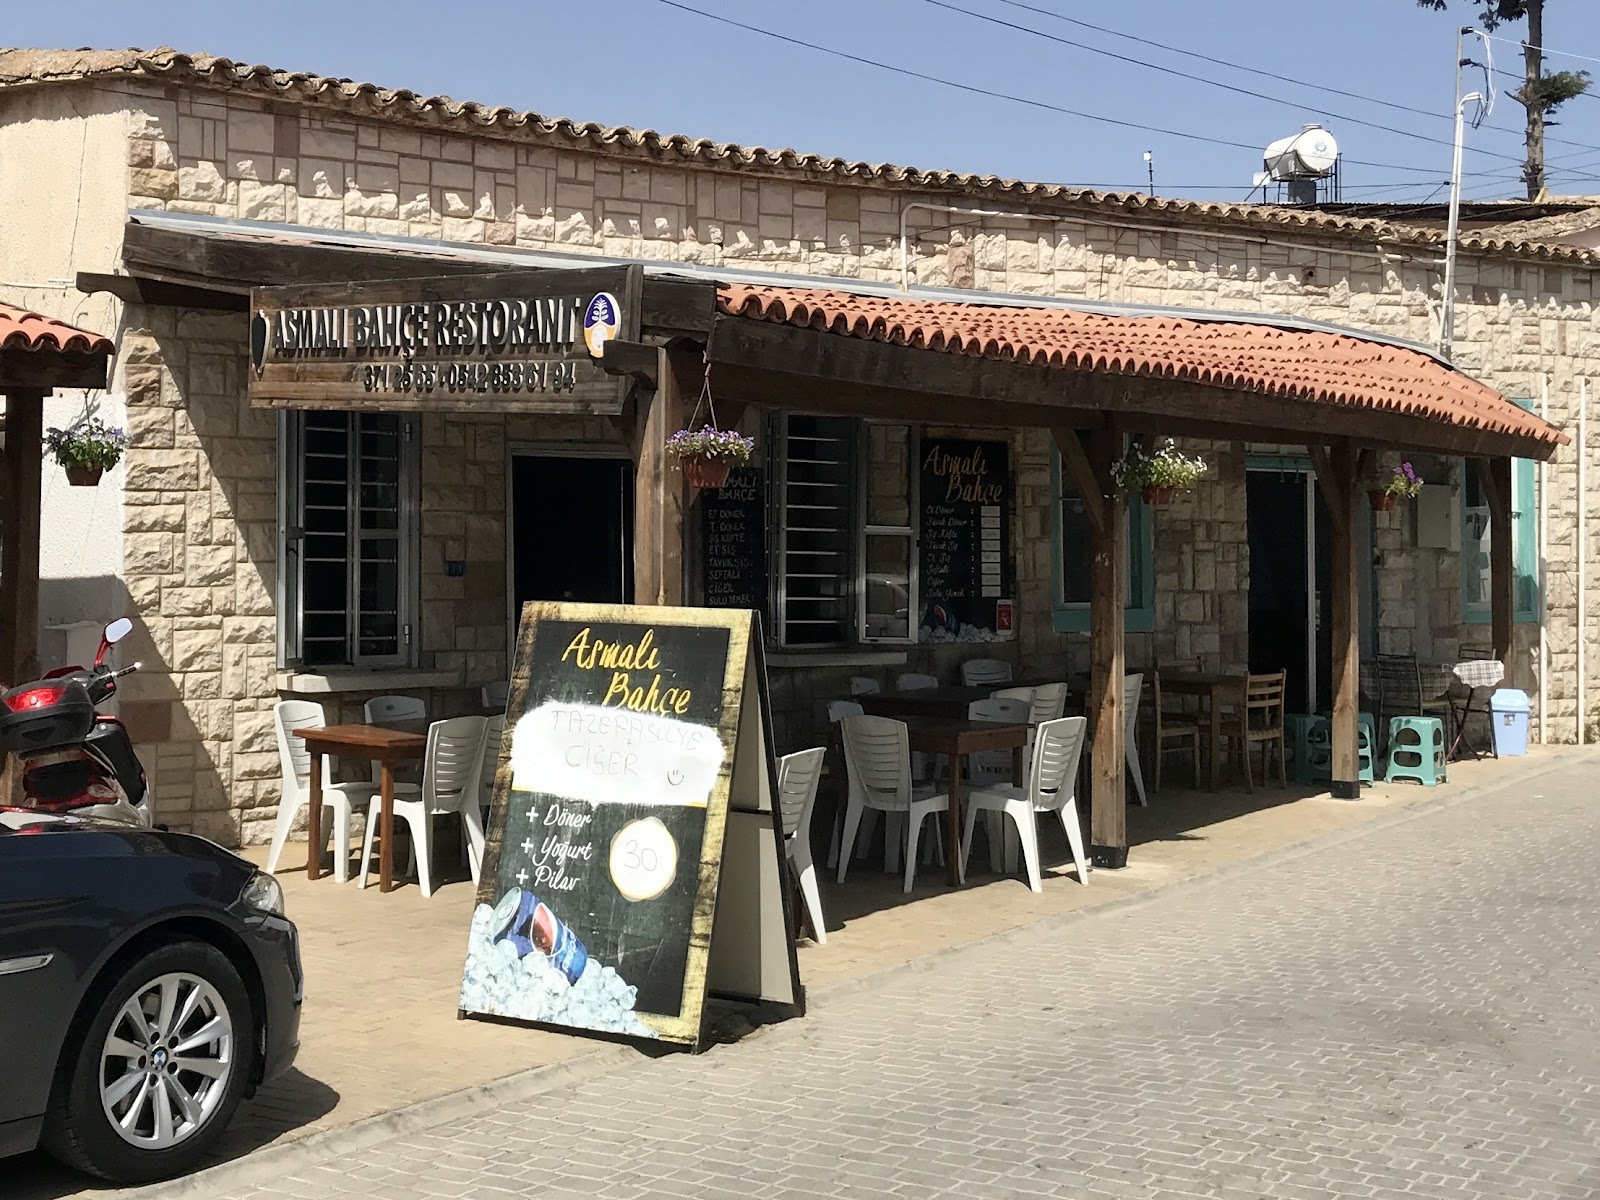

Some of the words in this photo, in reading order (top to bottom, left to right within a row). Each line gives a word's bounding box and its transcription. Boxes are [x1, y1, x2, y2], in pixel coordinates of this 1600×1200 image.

[272, 308, 348, 350] ASMALI
[353, 304, 429, 359] BAHÇE
[434, 298, 580, 347] RESTORANT
[365, 364, 389, 390] 371
[561, 627, 661, 670] Asmalı
[602, 671, 691, 717] Bahçe
[544, 804, 592, 828] Döner
[532, 834, 593, 866] Yoğurt
[623, 839, 658, 872] 30
[534, 865, 580, 891] Pilav
